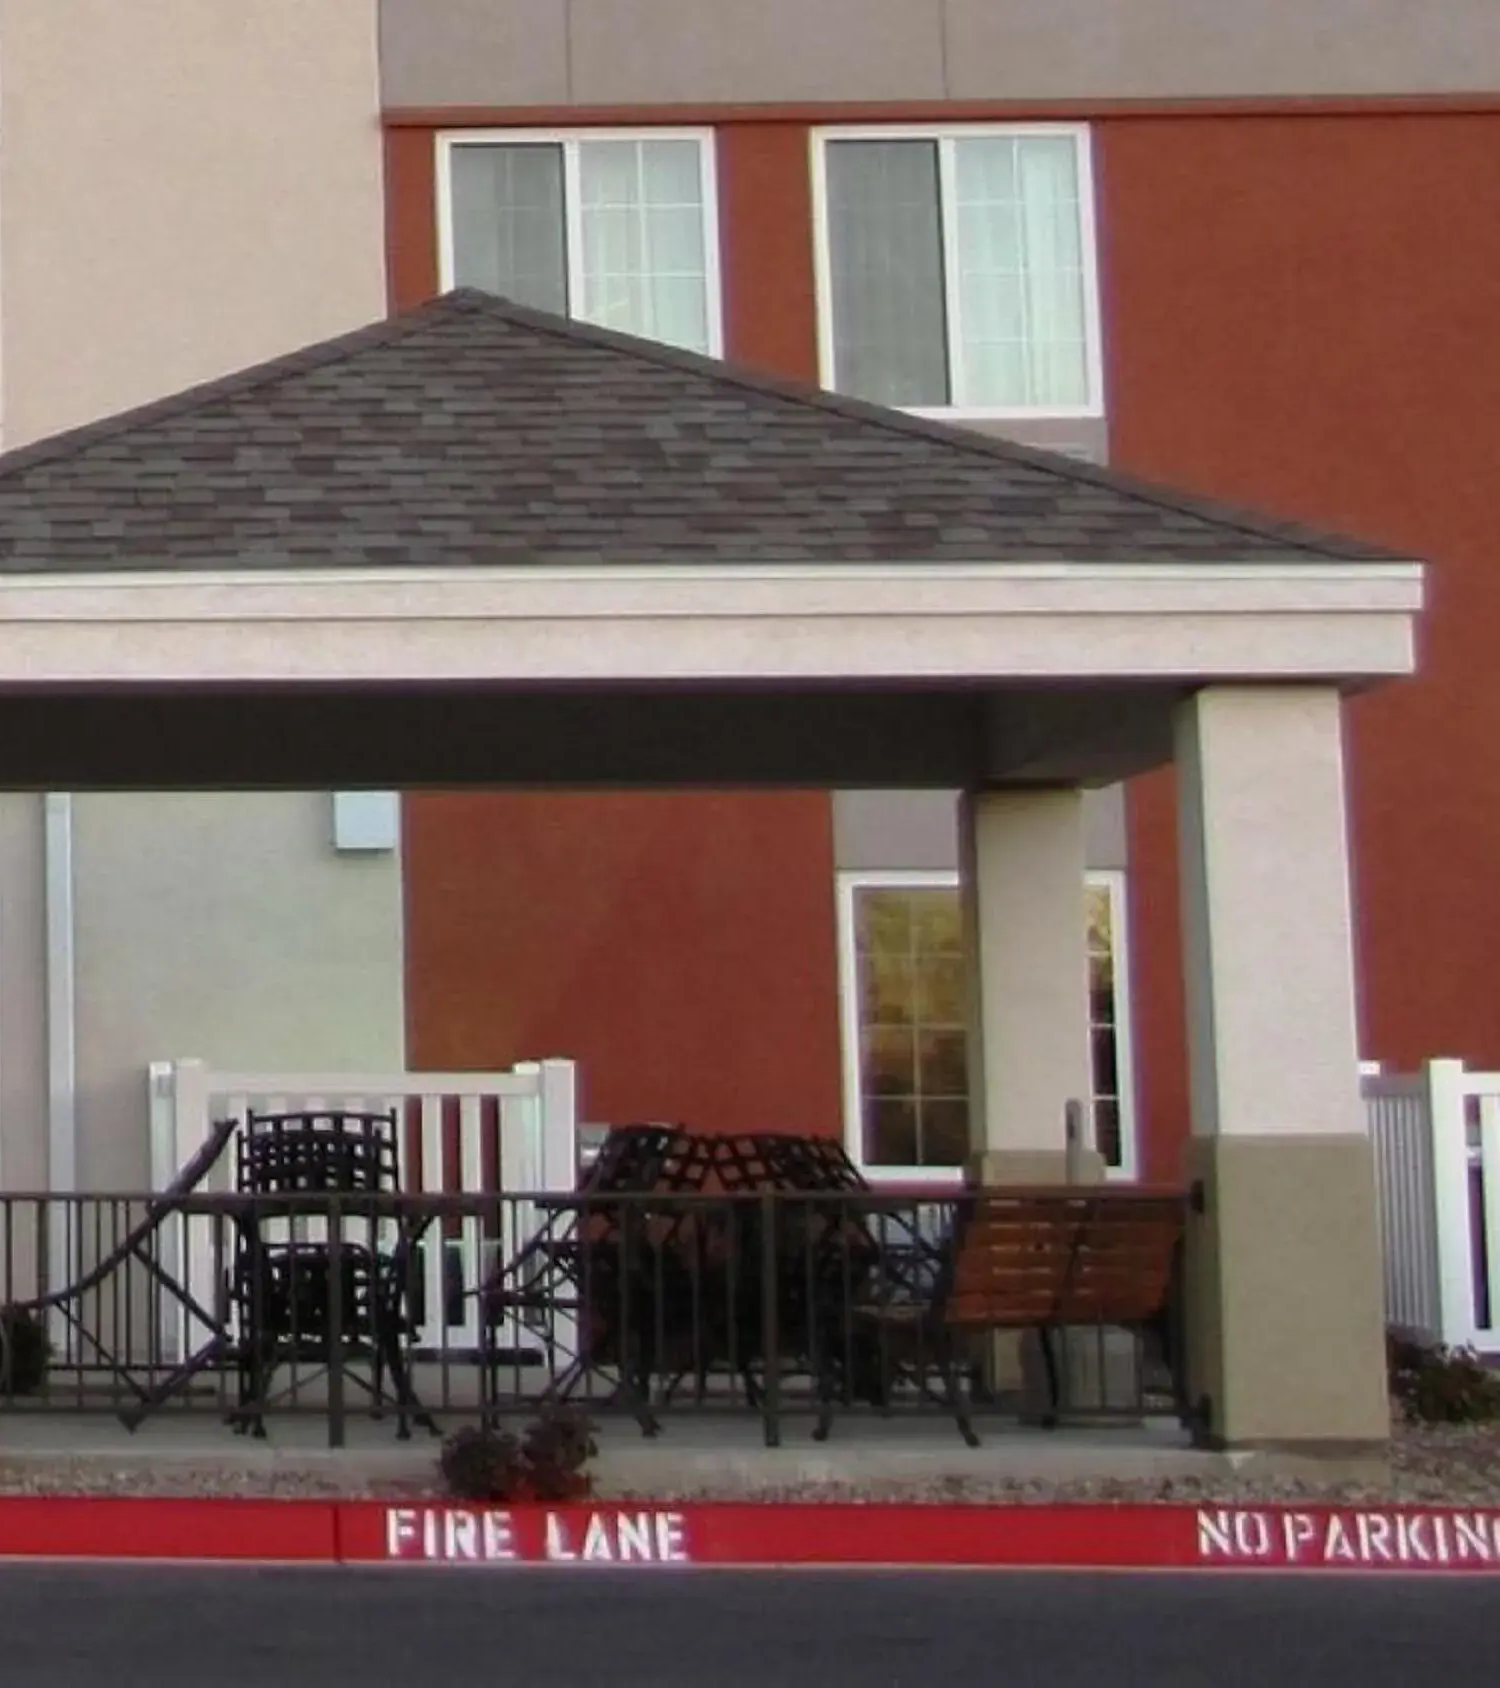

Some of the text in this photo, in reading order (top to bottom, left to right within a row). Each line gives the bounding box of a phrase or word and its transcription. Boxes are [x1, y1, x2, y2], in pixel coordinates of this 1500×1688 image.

[387, 1508, 688, 1563] FIRE LANE
[1196, 1509, 1500, 1562] NO PARKIN
